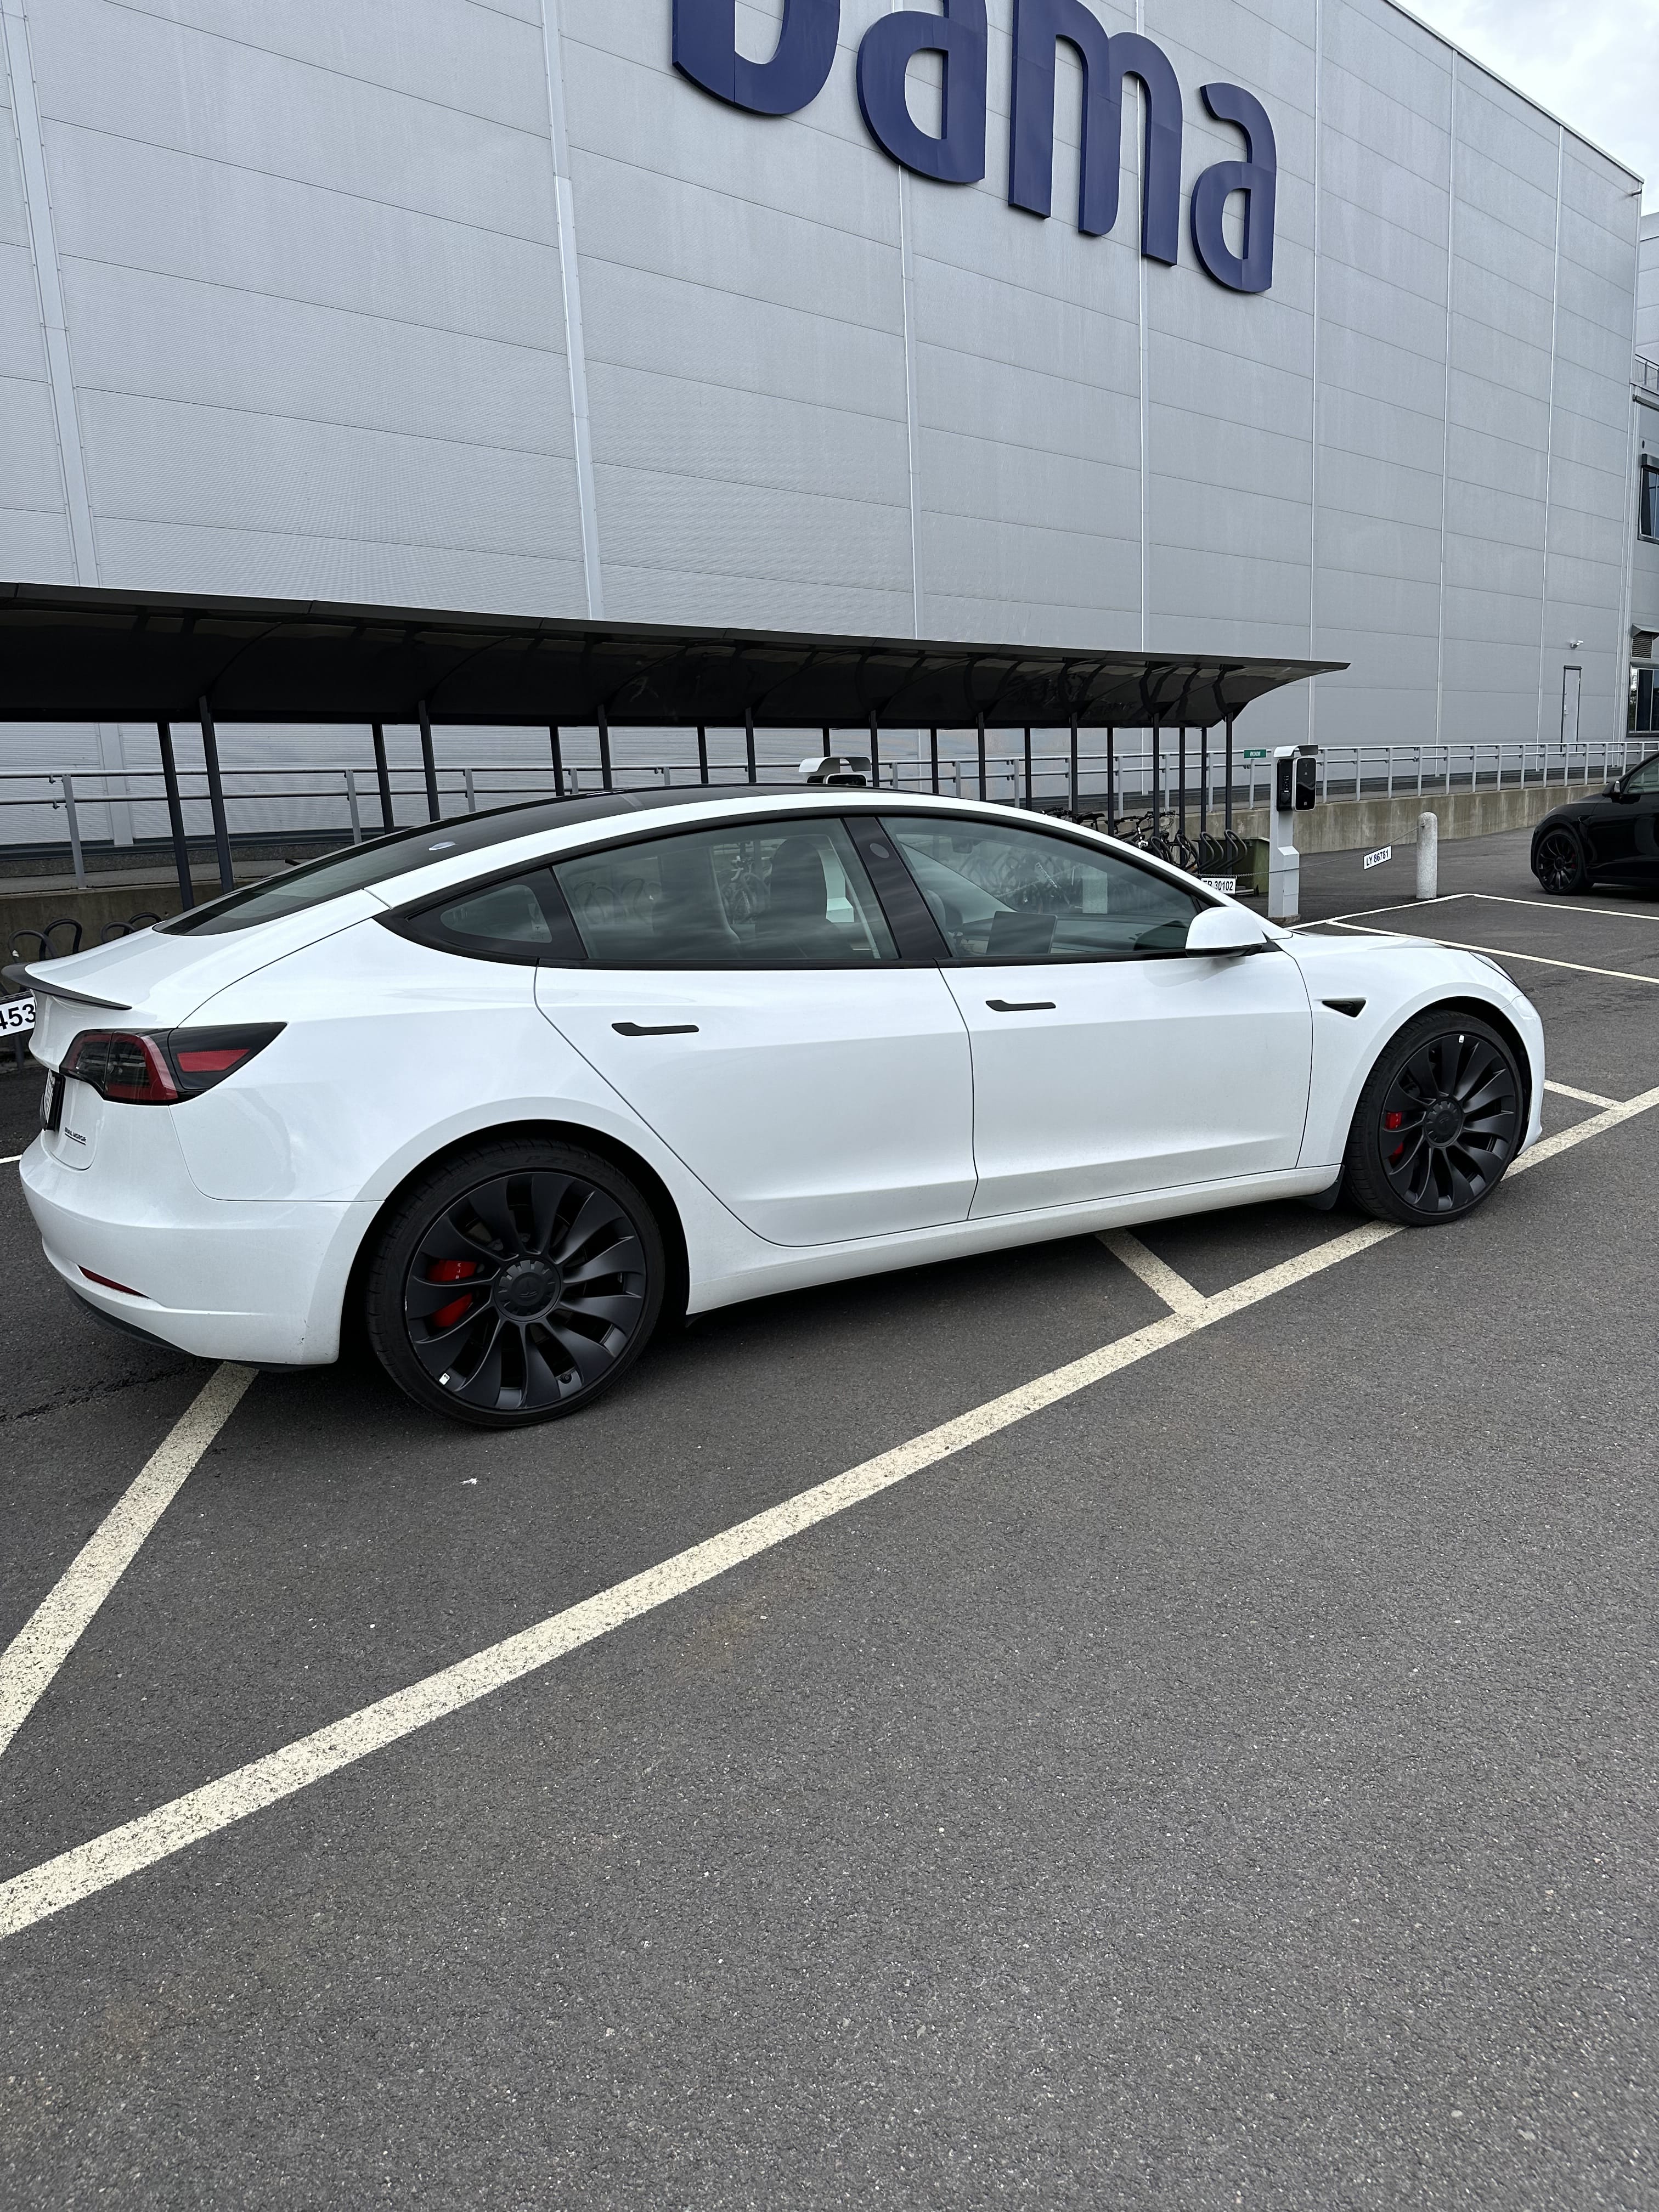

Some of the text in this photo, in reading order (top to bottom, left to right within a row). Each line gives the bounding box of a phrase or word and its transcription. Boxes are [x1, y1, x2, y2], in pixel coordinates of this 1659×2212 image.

[1366, 849, 1389, 866] LY 86781
[1215, 881, 1233, 891] 30102
